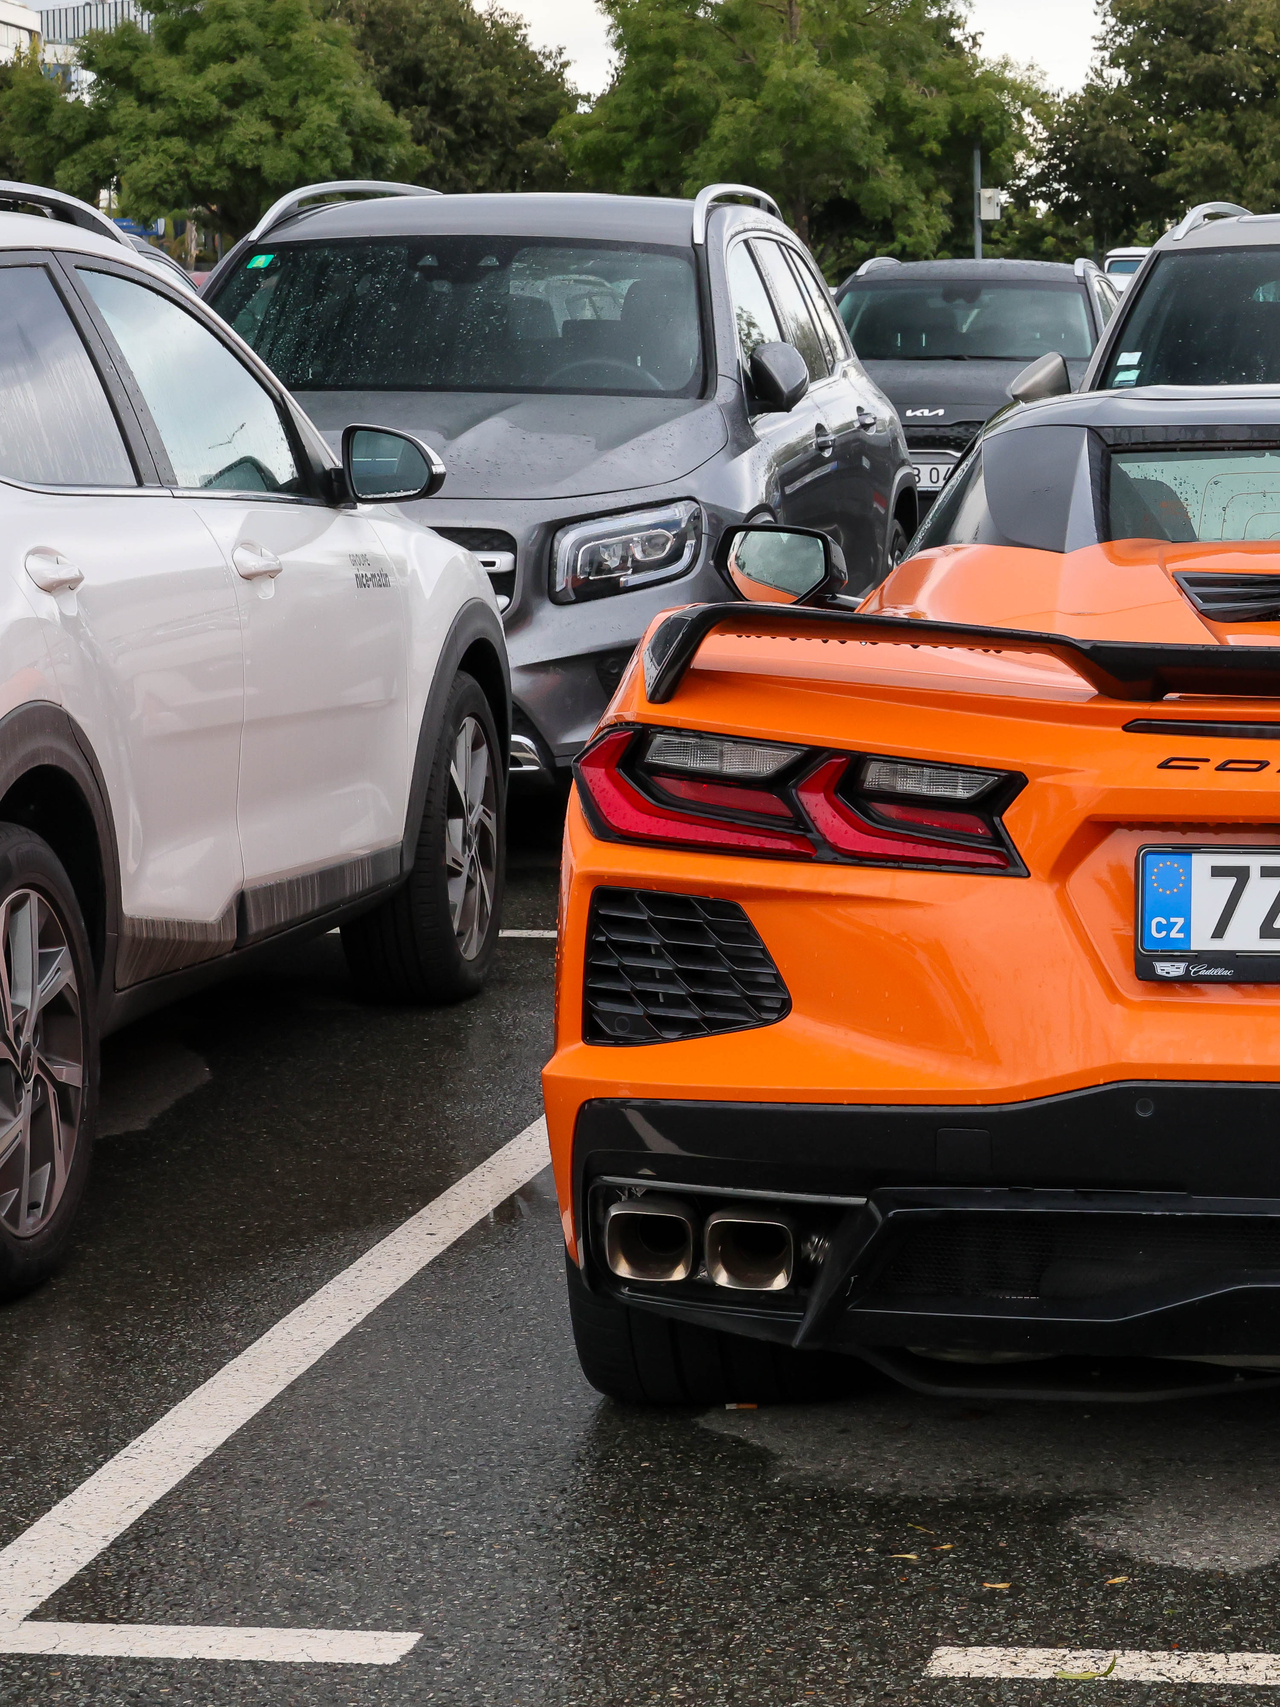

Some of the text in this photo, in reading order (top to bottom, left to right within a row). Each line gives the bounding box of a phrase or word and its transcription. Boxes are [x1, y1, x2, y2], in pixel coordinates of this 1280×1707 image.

[905, 408, 945, 417] KIA
[1150, 917, 1185, 939] CZ
[1189, 963, 1234, 977] Cadillac
